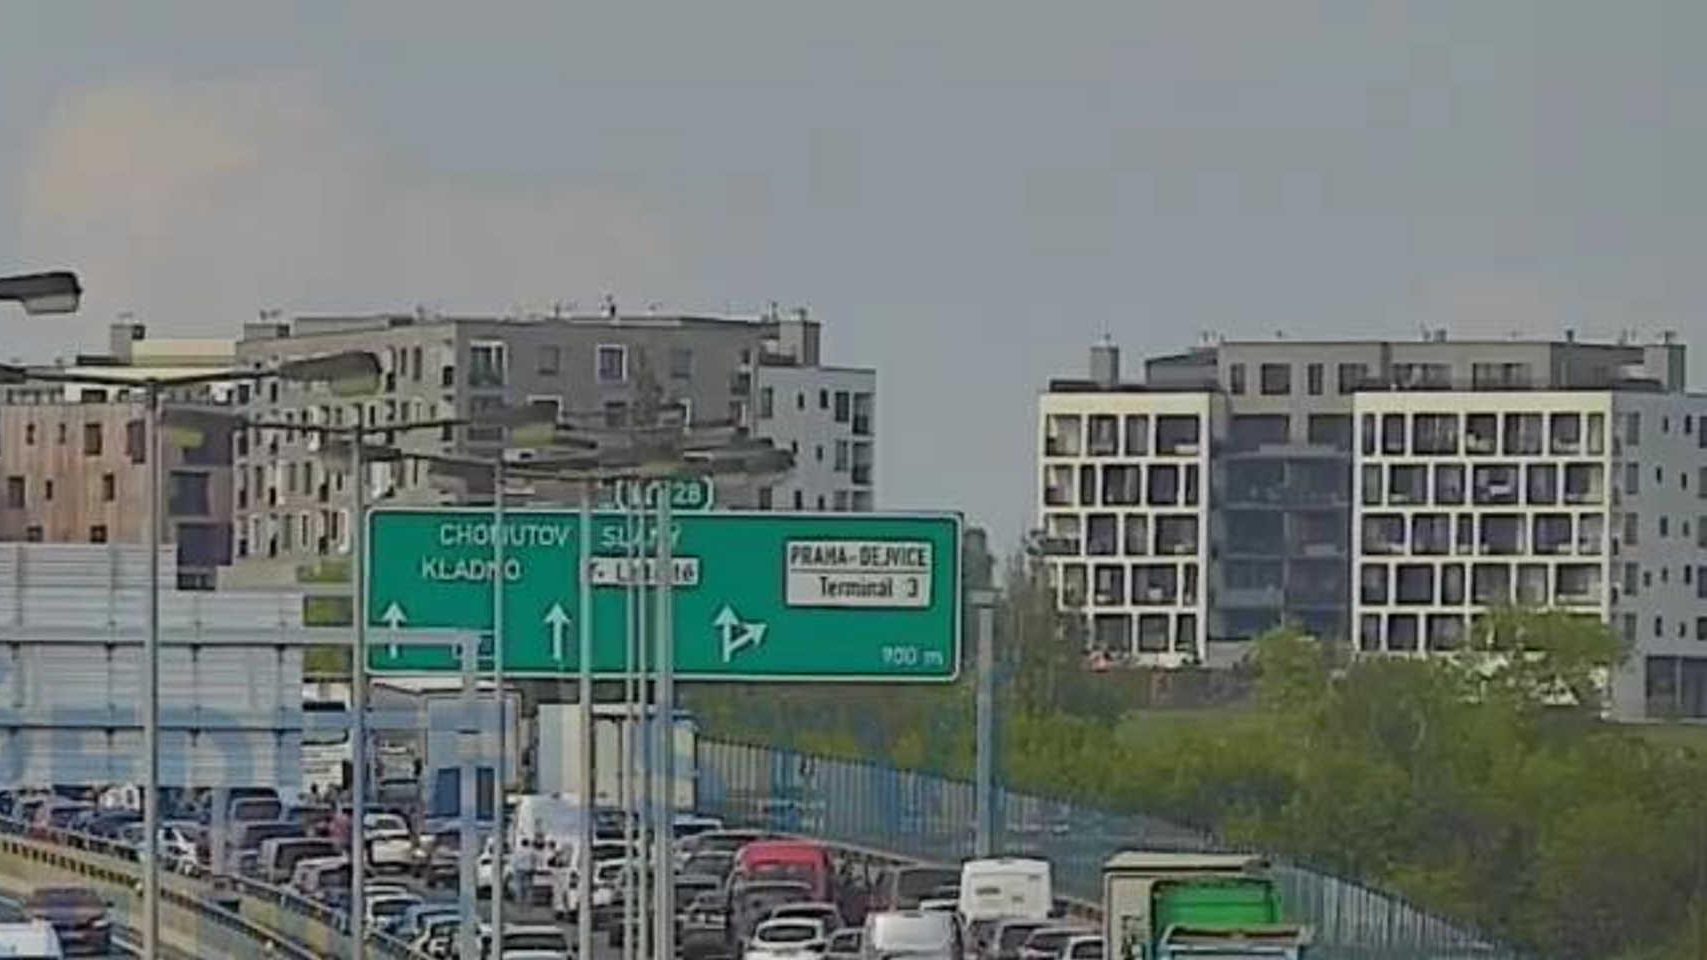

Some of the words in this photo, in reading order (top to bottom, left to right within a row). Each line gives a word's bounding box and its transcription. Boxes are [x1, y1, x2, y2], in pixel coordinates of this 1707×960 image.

[440, 523, 571, 547] CHOMUTOV
[790, 545, 928, 567] PRAHA-DEJVICE
[820, 576, 893, 599] Terminal
[907, 577, 919, 599] 3
